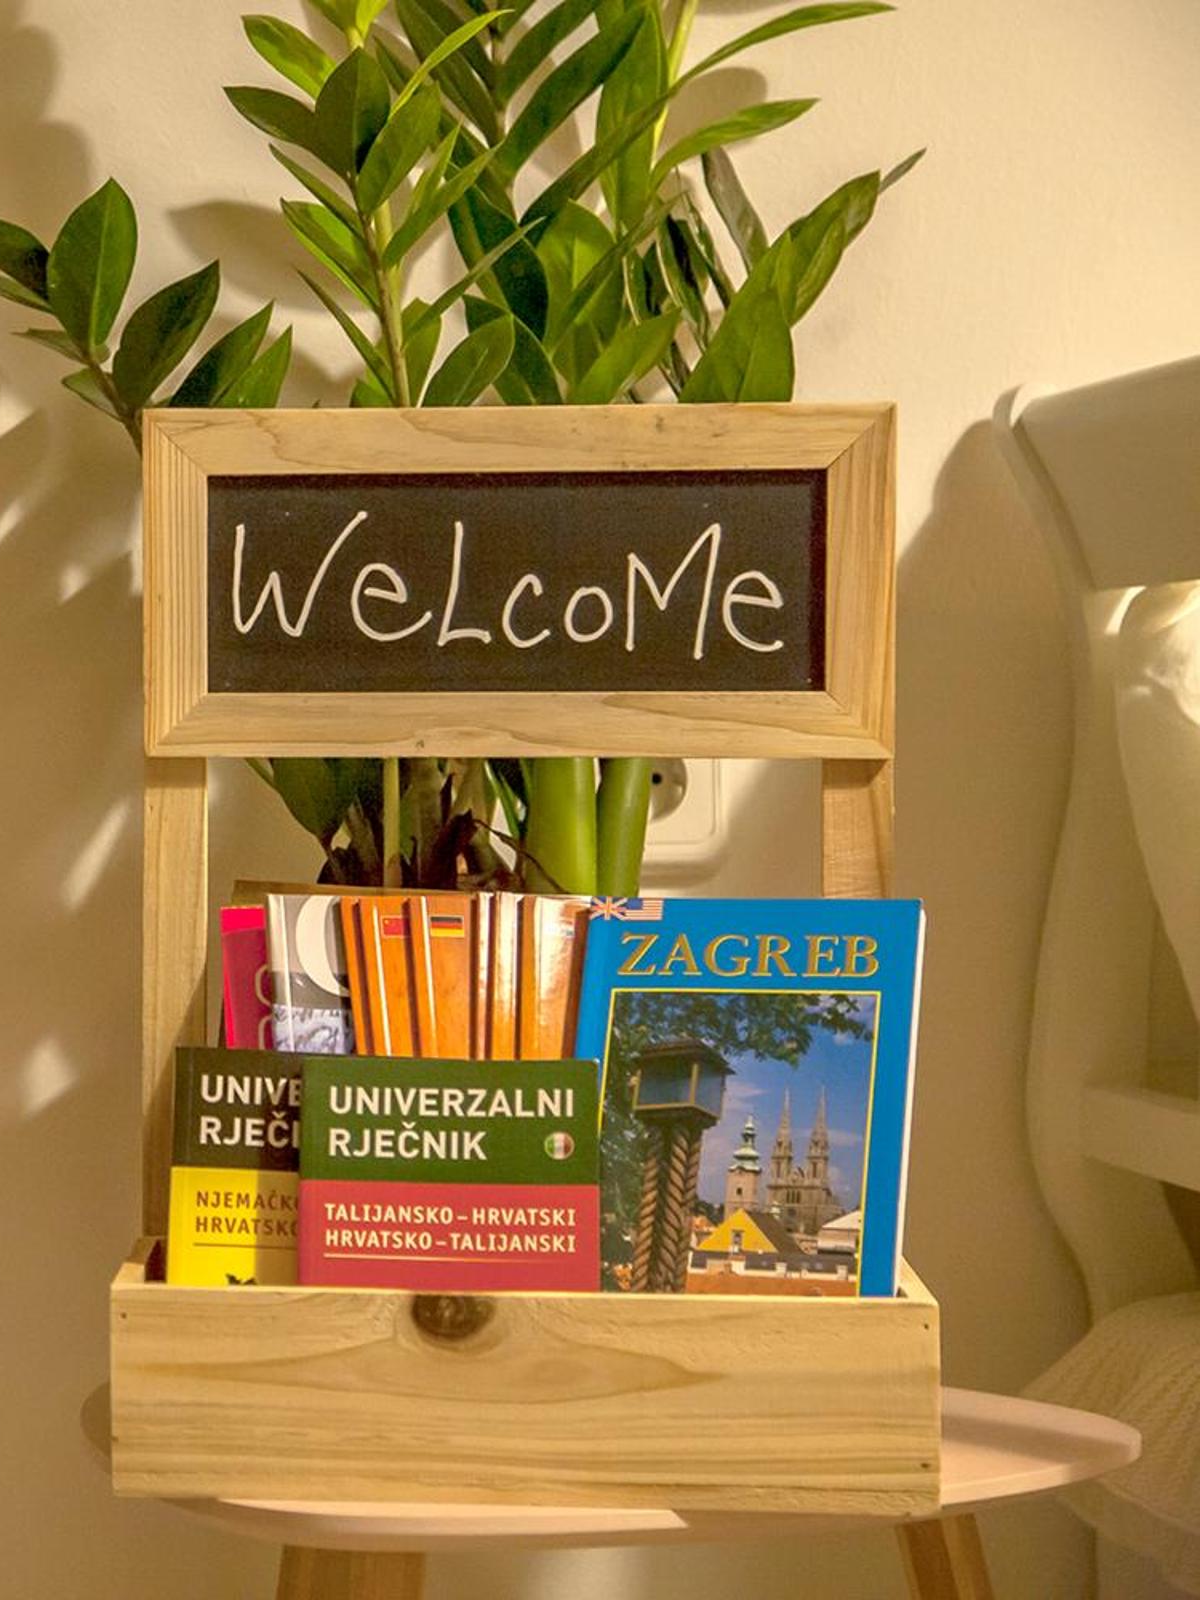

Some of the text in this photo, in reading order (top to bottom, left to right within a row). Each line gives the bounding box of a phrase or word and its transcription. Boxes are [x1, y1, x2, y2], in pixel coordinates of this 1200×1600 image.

[616, 931, 880, 978] ZAGREB
[329, 1085, 574, 1118] UNIVERZALNI
[328, 1121, 488, 1161] RJEČNIK
